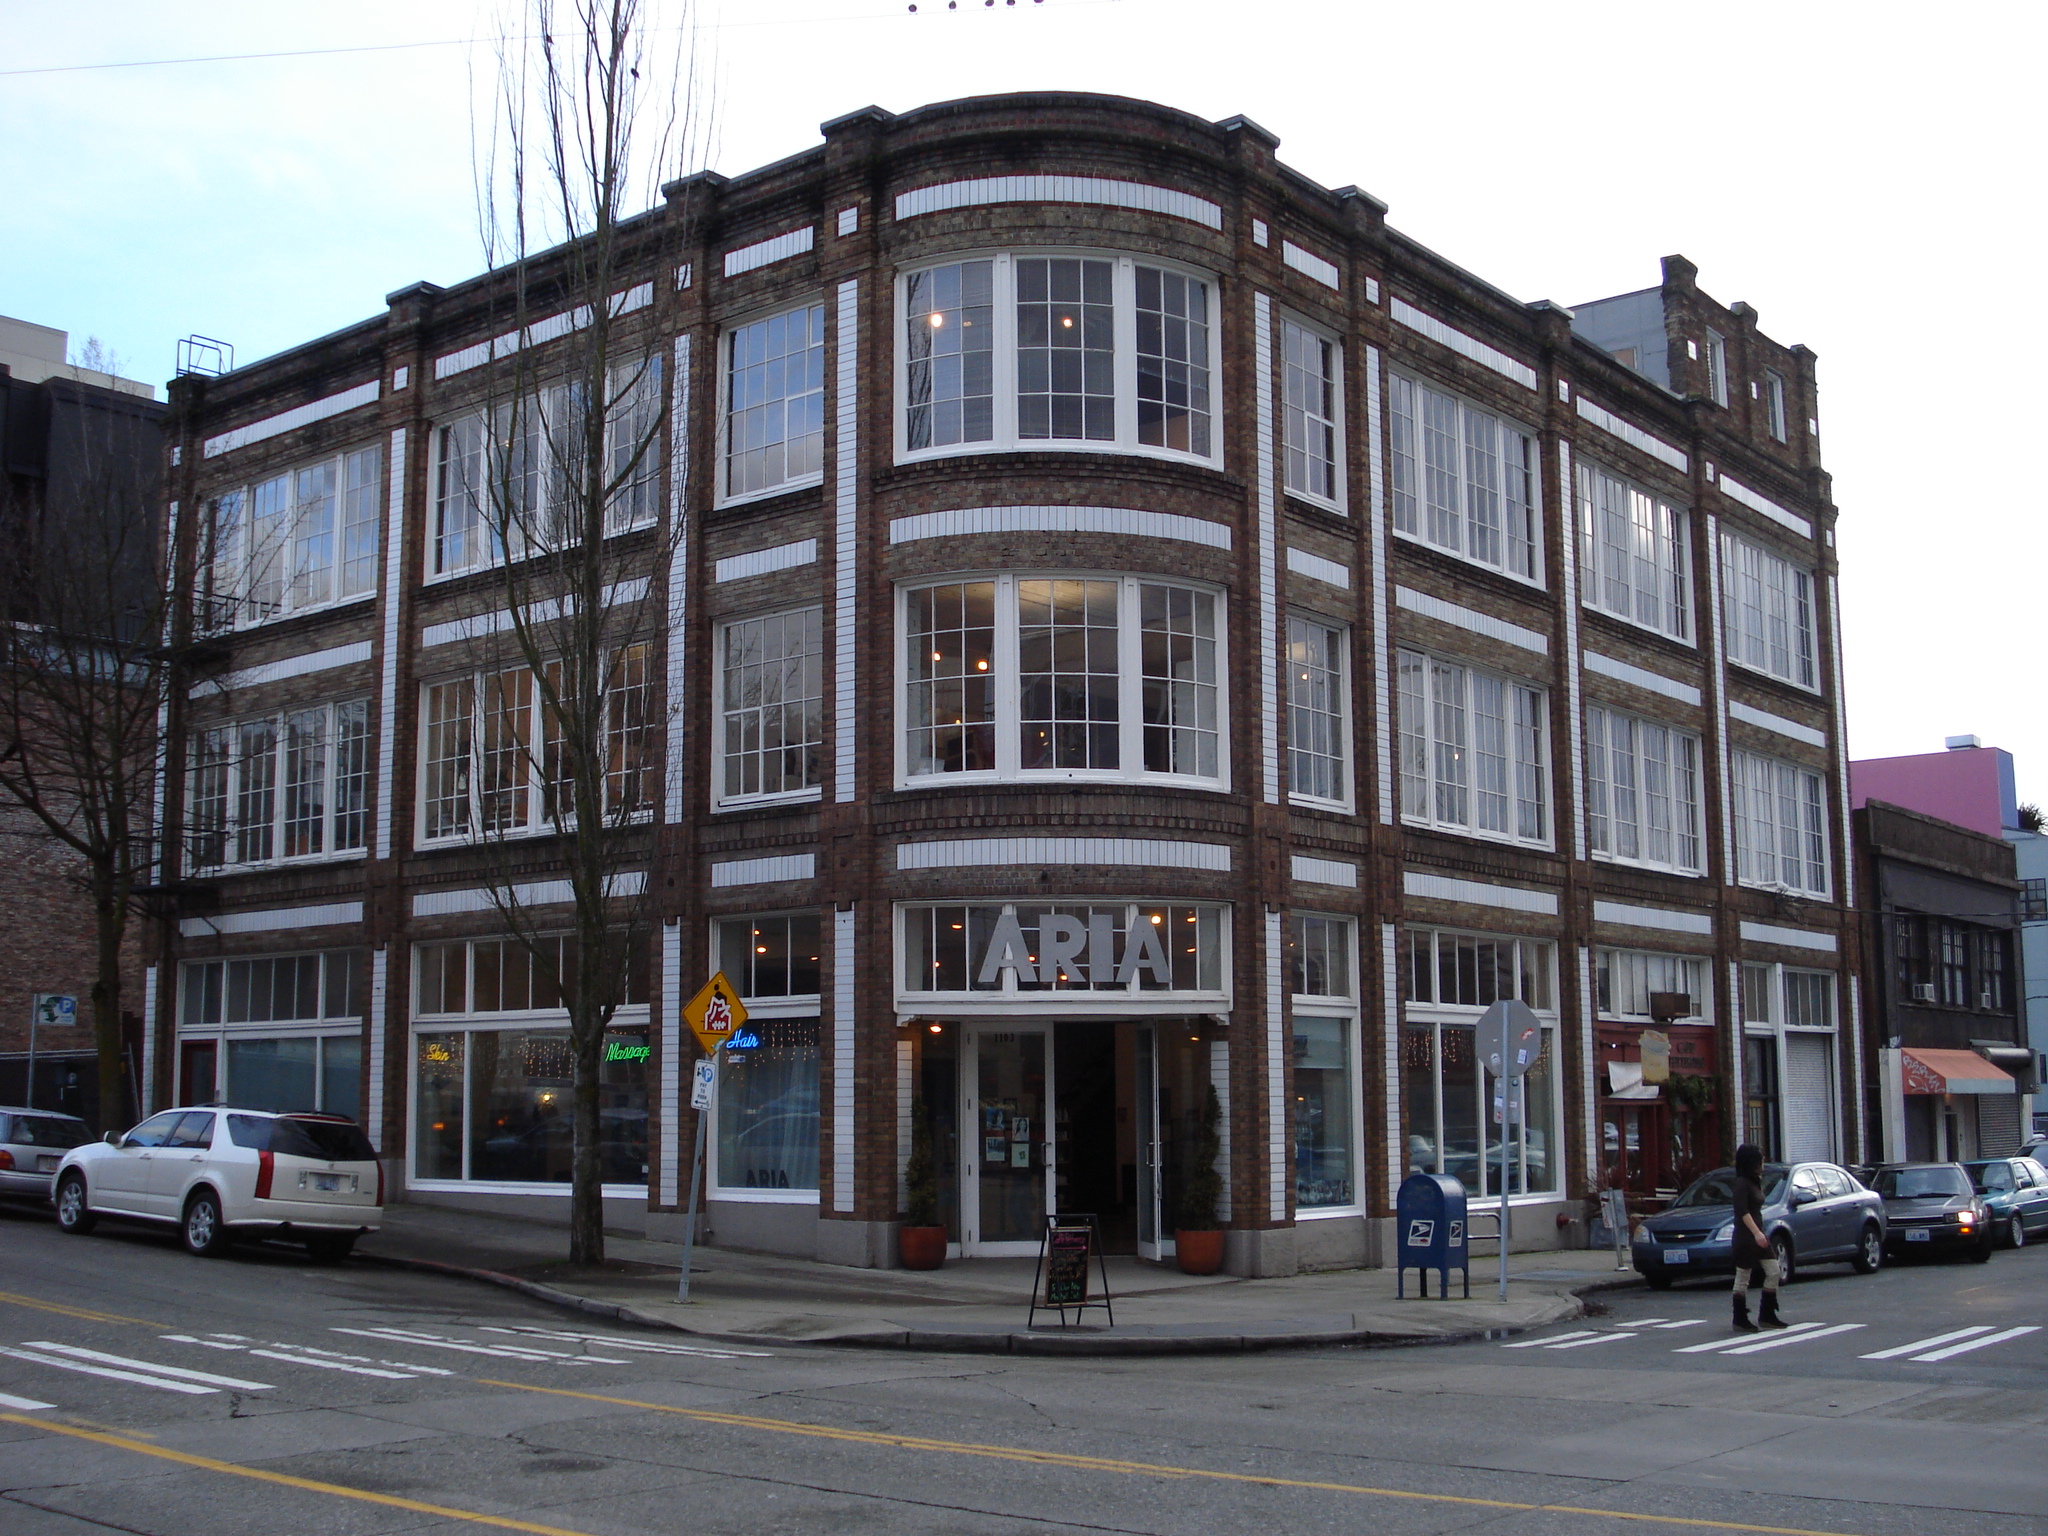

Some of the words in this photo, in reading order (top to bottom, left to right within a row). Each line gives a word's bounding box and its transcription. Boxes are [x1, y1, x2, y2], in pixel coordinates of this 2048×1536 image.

[978, 914, 1171, 983] ARIA
[726, 1029, 758, 1048] Hair
[427, 1043, 450, 1061] Skin
[746, 1168, 789, 1188] ARIA
